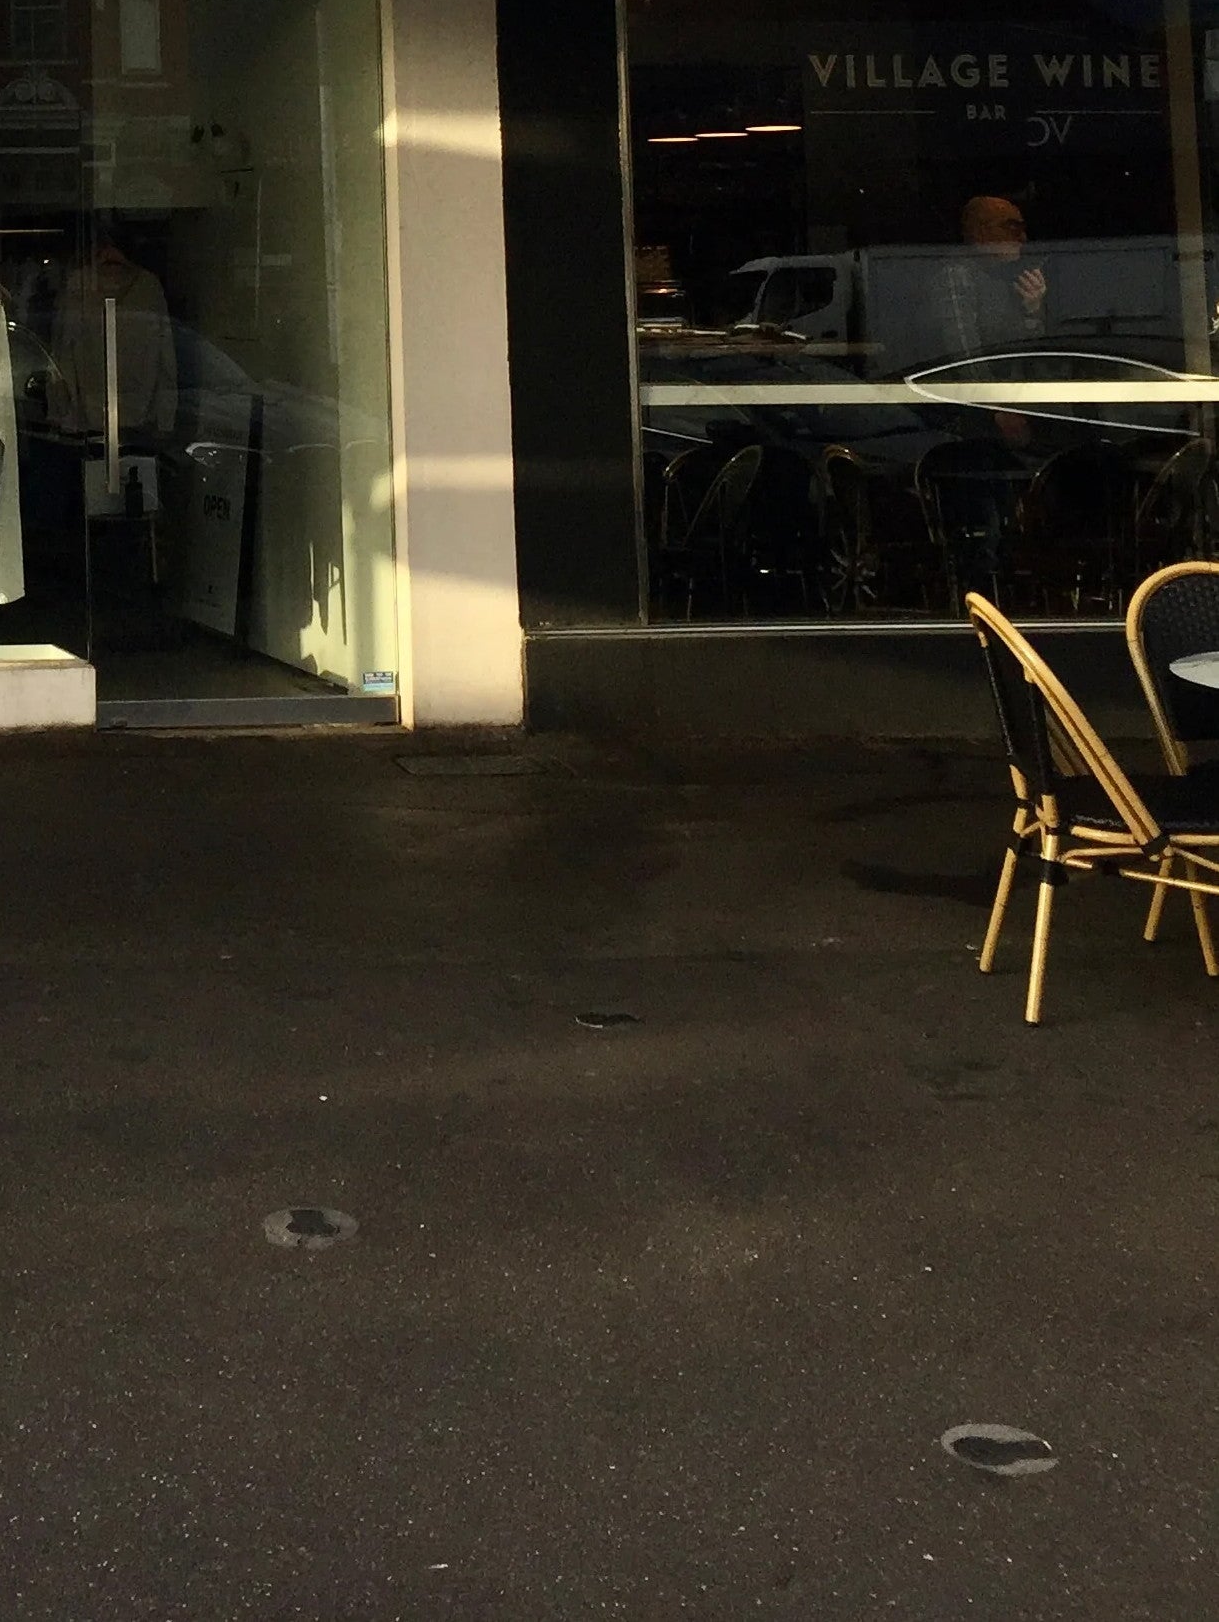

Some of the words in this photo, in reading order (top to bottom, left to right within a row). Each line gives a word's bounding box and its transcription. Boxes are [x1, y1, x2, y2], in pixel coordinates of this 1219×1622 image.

[807, 53, 1010, 89] VILLAGE
[1033, 53, 1162, 89] WINE
[966, 103, 1007, 121] BAR
